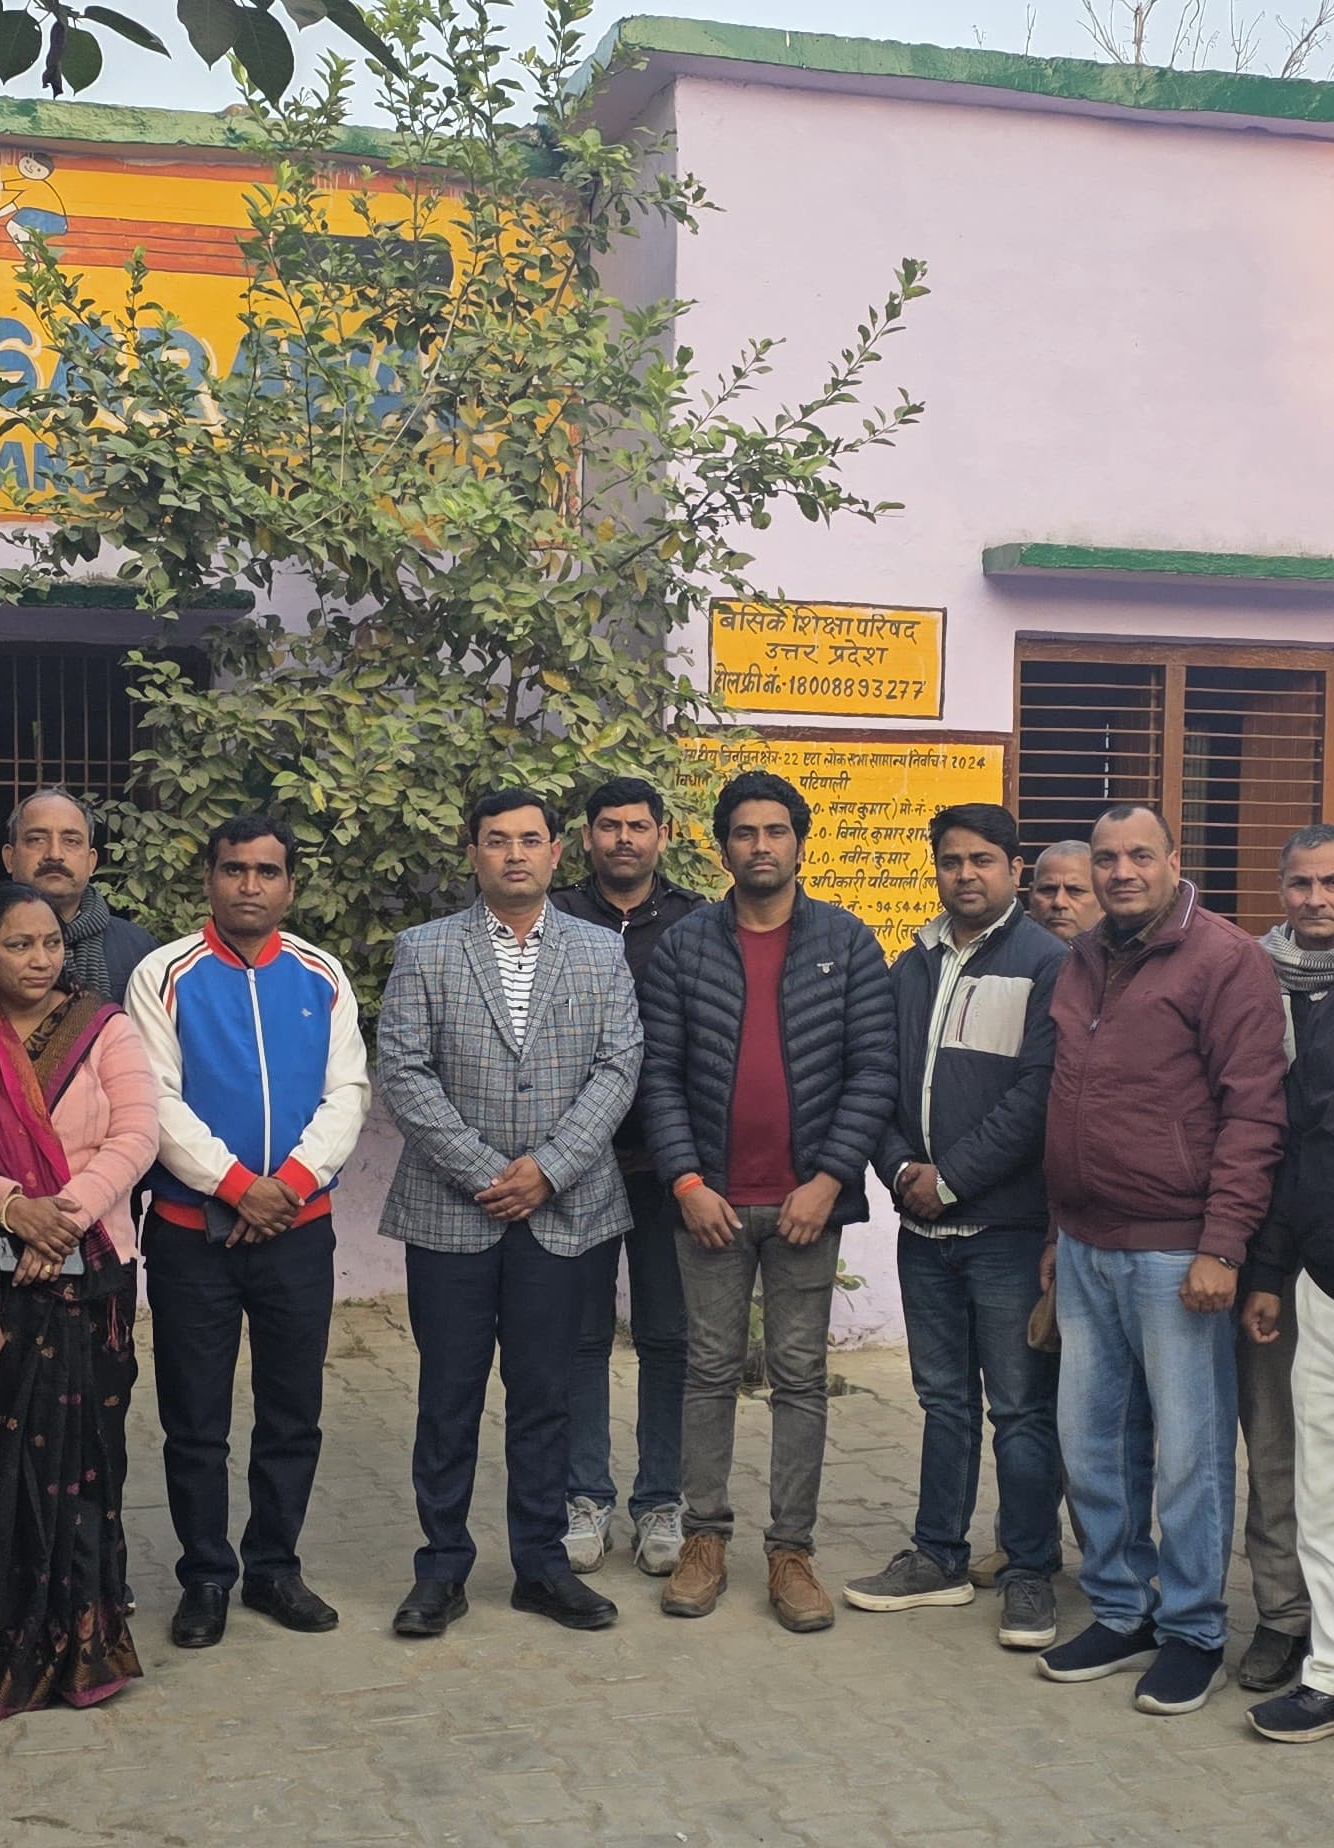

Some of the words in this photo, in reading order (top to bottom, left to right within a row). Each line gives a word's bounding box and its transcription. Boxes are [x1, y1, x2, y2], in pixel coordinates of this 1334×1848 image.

[791, 606, 855, 636] शिक्षा
[857, 614, 920, 644] परिषद
[765, 642, 819, 664] उत्तर
[828, 639, 889, 666] प्रदेश
[789, 675, 926, 701] 18008893277
[871, 827, 906, 846] कुमार
